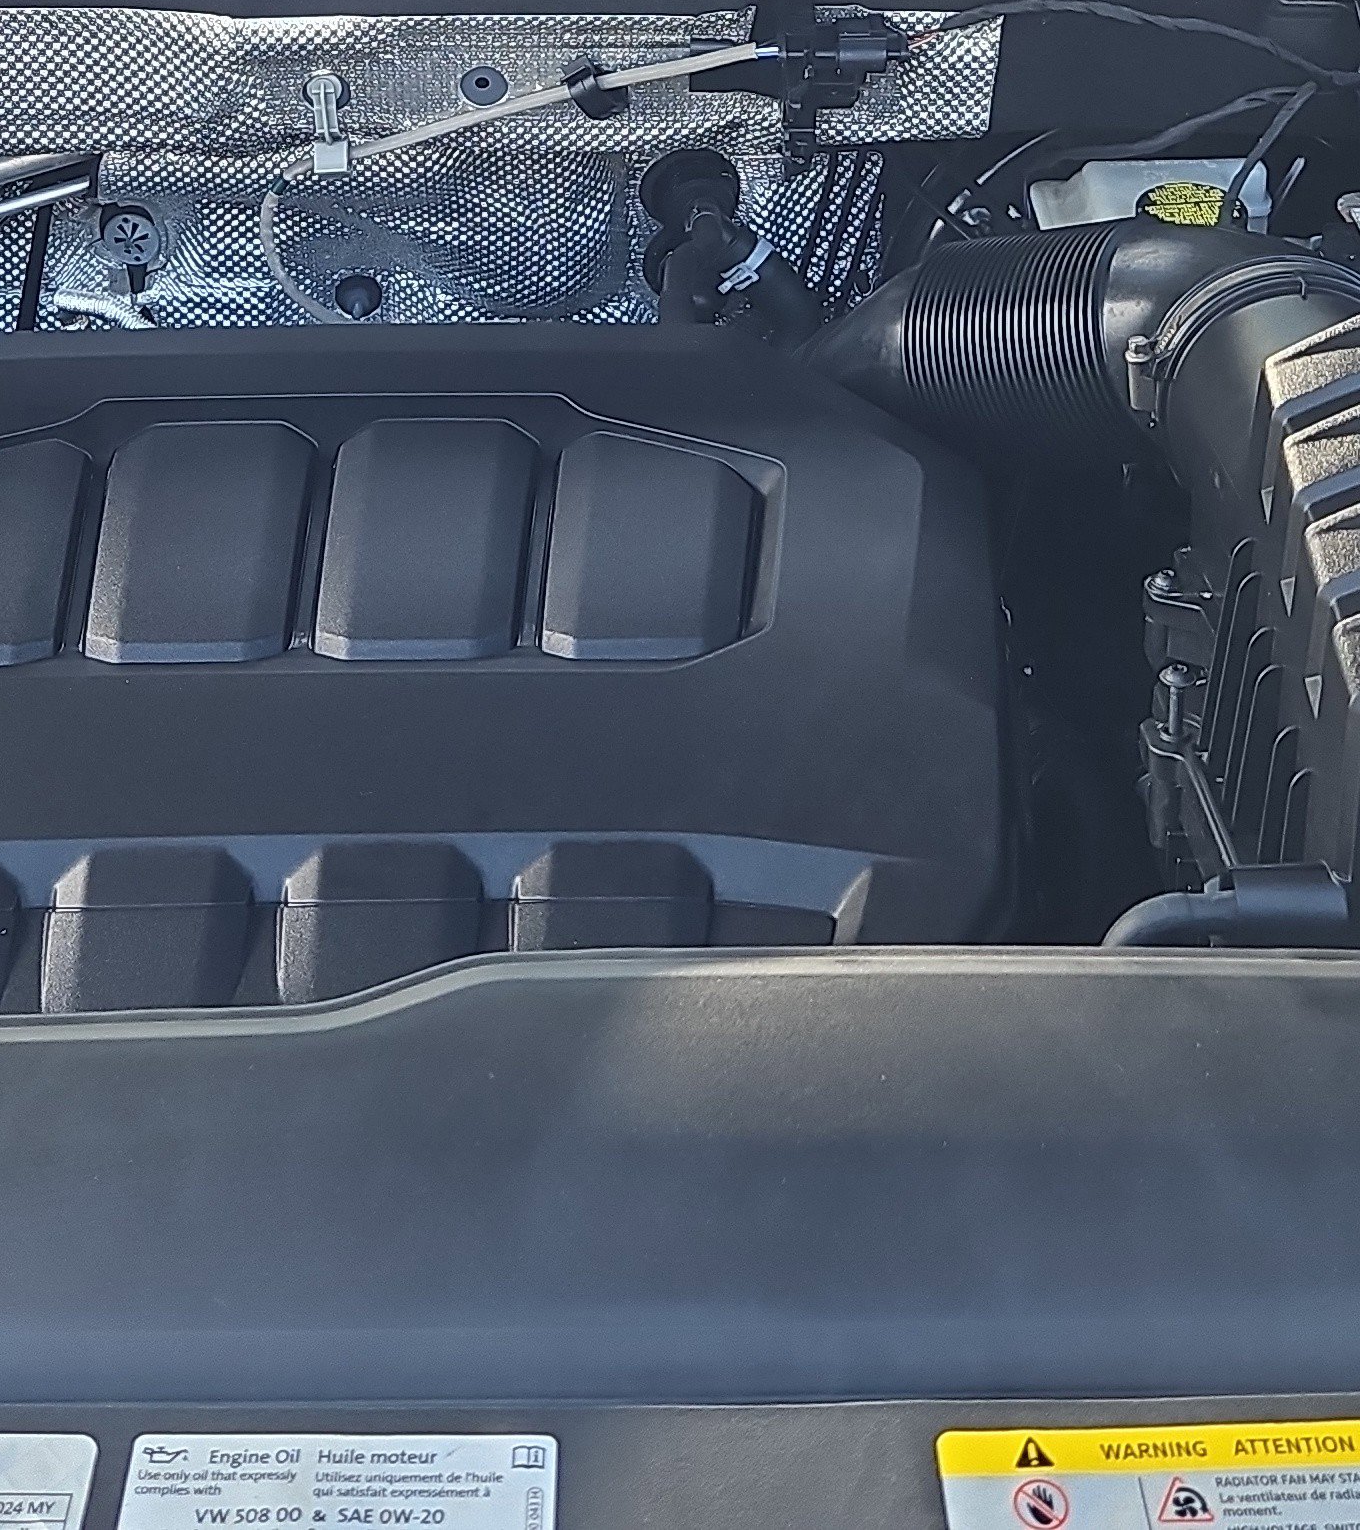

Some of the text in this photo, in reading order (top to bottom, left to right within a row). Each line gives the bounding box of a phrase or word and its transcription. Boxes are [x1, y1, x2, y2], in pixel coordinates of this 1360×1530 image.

[1100, 1435, 1356, 1460] WARNING ATTENTION
[208, 1448, 302, 1468] Engine Oil
[317, 1449, 438, 1465] Huile moteur
[163, 1471, 191, 1484] only
[193, 1471, 208, 1481] oil
[210, 1471, 238, 1481] that
[240, 1471, 298, 1484] expressly
[315, 1471, 362, 1483] Utilisez
[364, 1471, 443, 1487] uniquement
[446, 1471, 462, 1483] de
[1215, 1474, 1279, 1488] RADIATOR
[1281, 1473, 1308, 1486] FAN
[1309, 1472, 1336, 1485] MAY
[134, 1483, 222, 1497] complies with
[312, 1486, 334, 1499] qui
[336, 1486, 388, 1498] satisfait
[390, 1486, 480, 1501] expressément
[1219, 1492, 1235, 1504] Le
[1236, 1490, 1308, 1503] ventilateur
[1310, 1489, 1327, 1501] de
[27, 1501, 56, 1515] MY
[195, 1506, 446, 1525] VW 508 00 & SAE 0W-20
[1223, 1505, 1283, 1517] moment.
